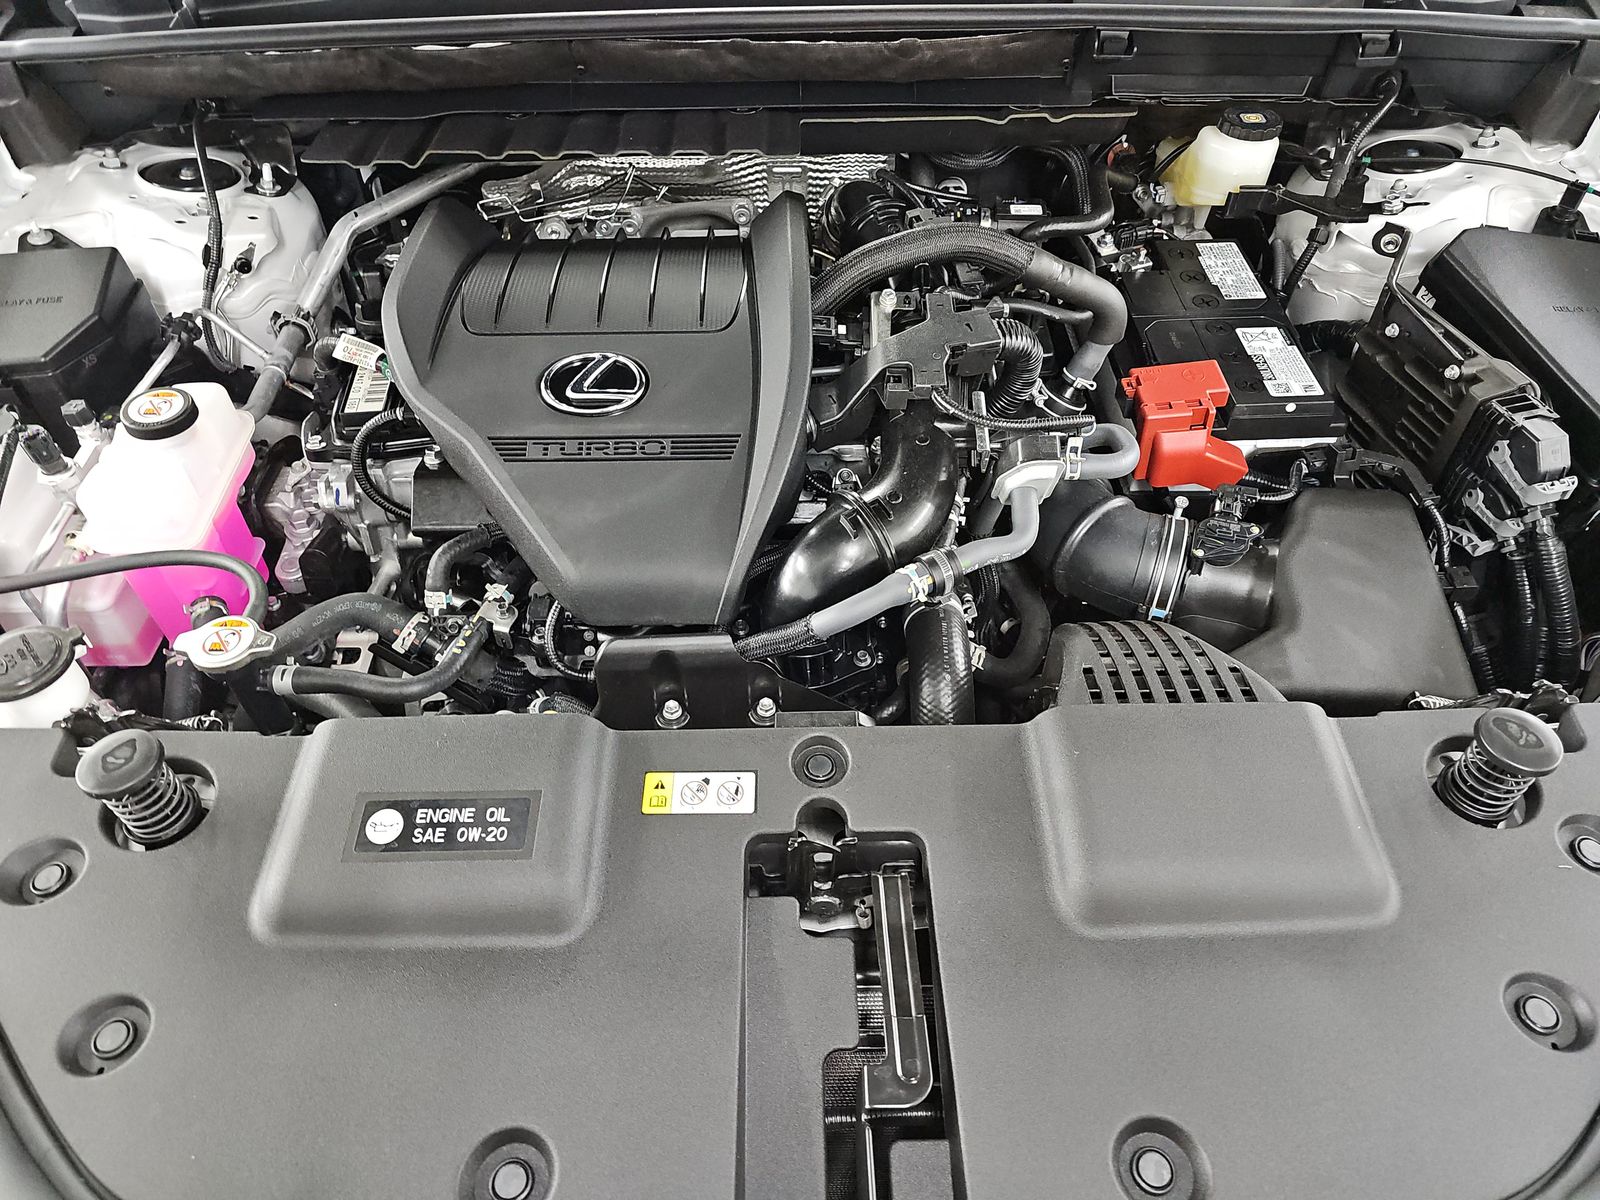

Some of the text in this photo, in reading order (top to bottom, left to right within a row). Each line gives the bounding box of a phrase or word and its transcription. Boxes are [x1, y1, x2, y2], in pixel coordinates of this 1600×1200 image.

[35, 296, 64, 305] FUSE
[531, 439, 667, 456] TURBO
[415, 806, 511, 823] ENGINE OIL
[411, 826, 508, 843] SAE 0W-20
